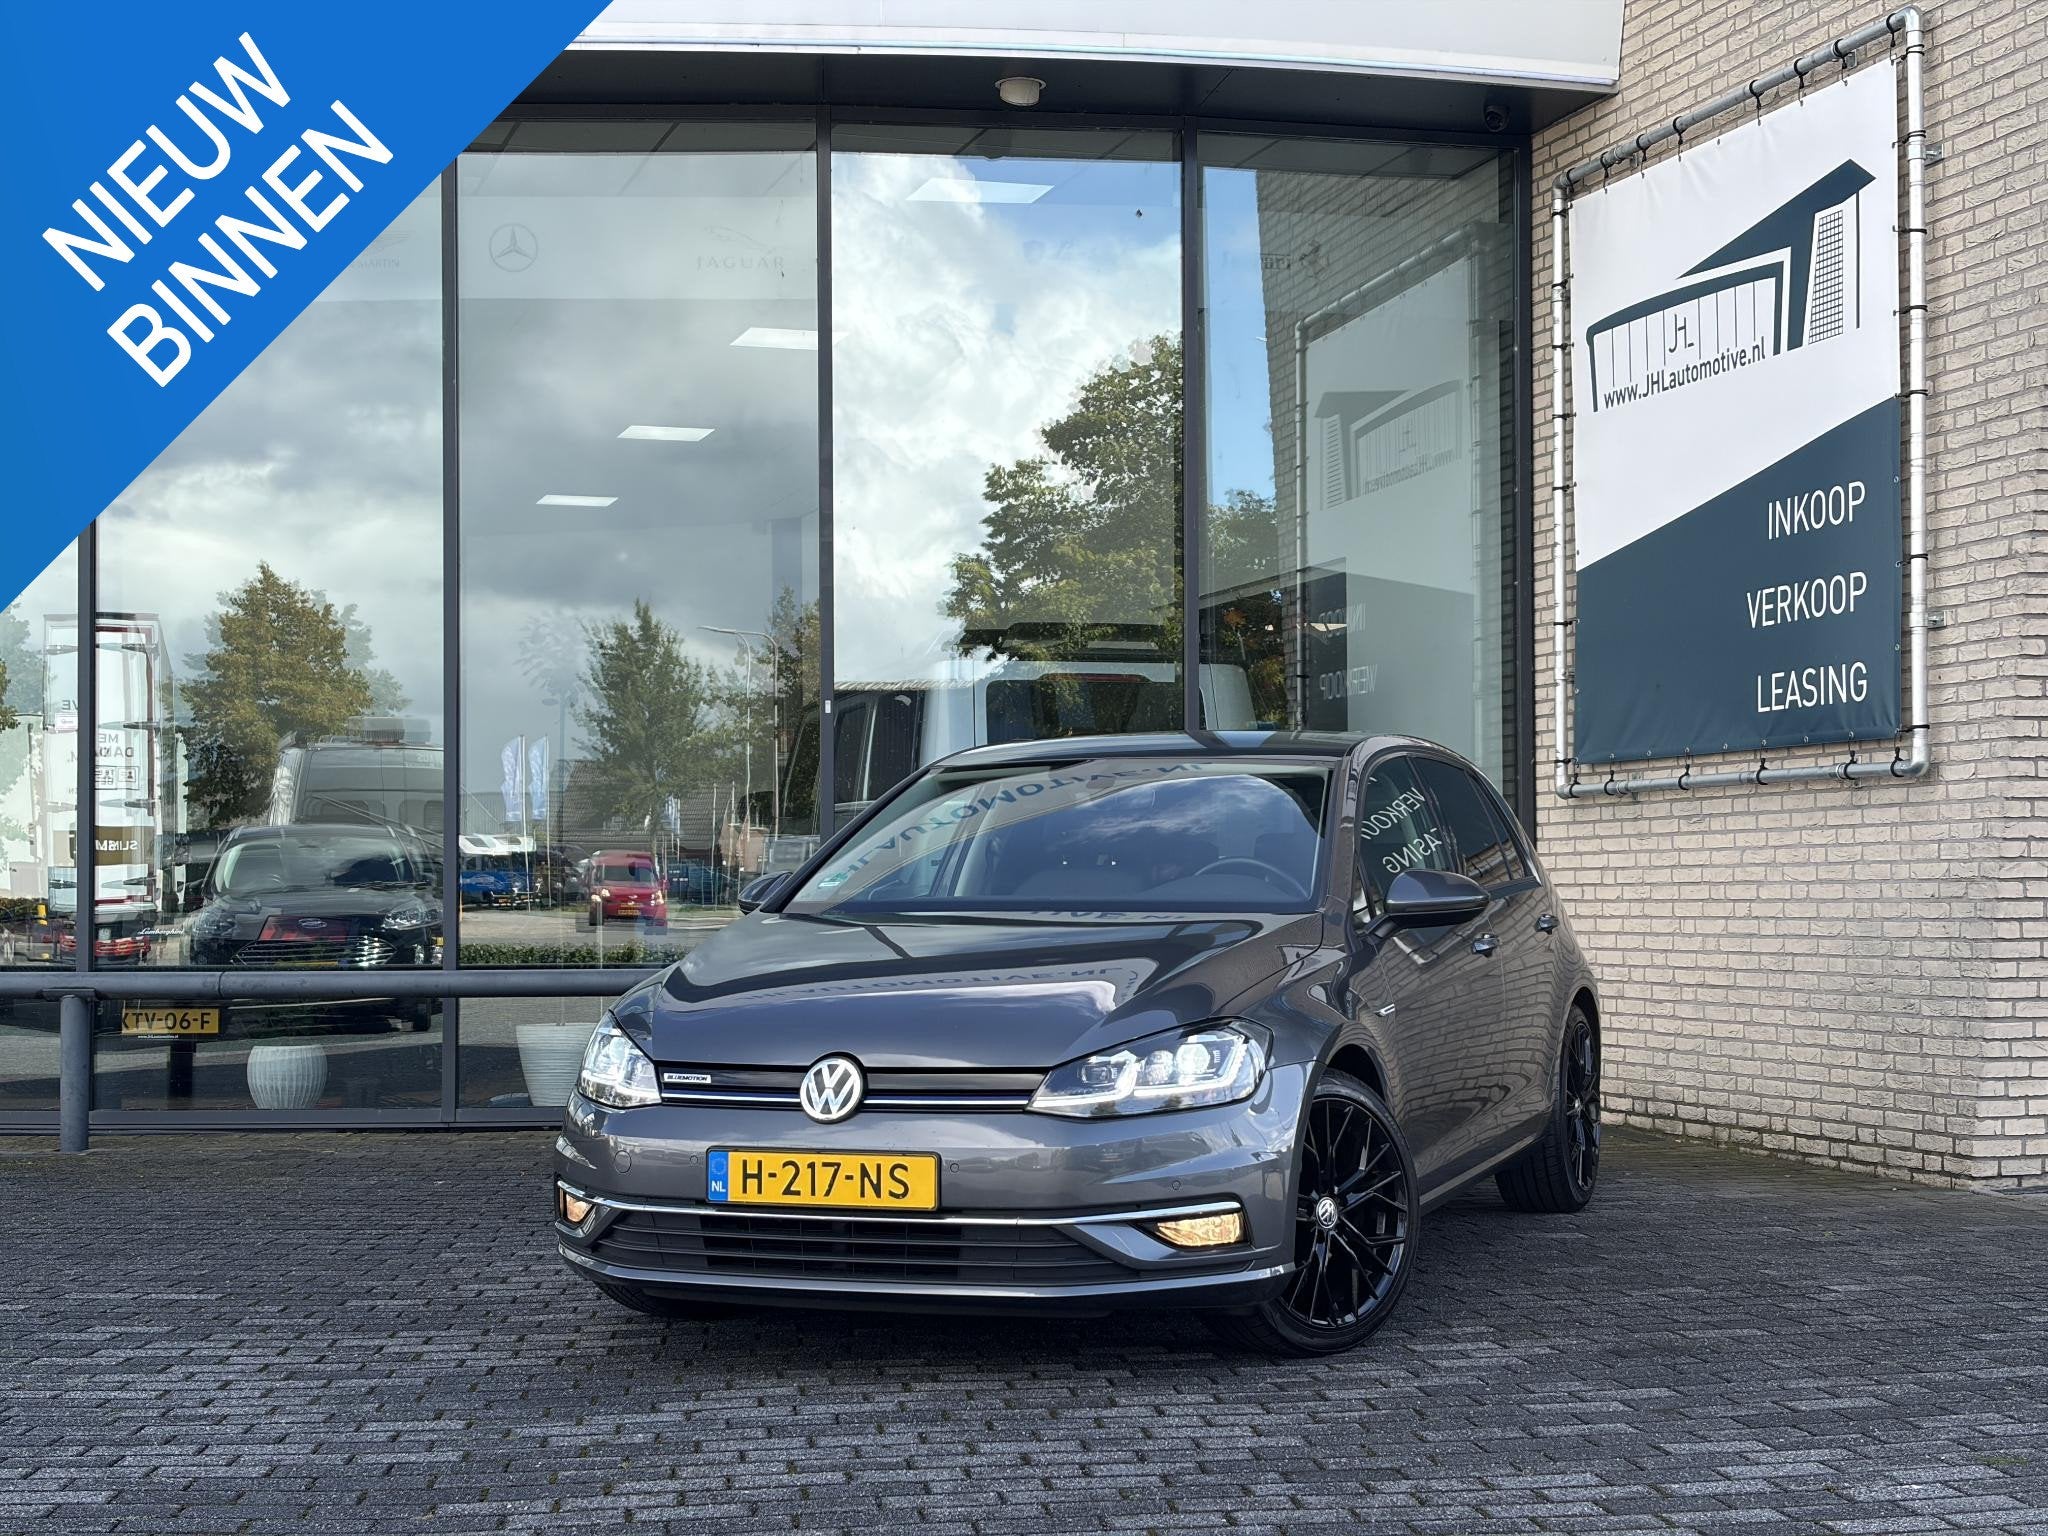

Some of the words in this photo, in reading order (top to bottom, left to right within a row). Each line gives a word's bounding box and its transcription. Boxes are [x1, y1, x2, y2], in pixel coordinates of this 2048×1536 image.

[1604, 336, 1766, 409] www.JHLautomotive.nl
[1768, 480, 1866, 540] INKOOP
[1746, 571, 1868, 629] VERKOOP
[1757, 661, 1869, 713] LEASING
[667, 1074, 708, 1082] BLUEMOTION
[711, 1181, 727, 1193] NL
[742, 1159, 910, 1200] H-217-NS
